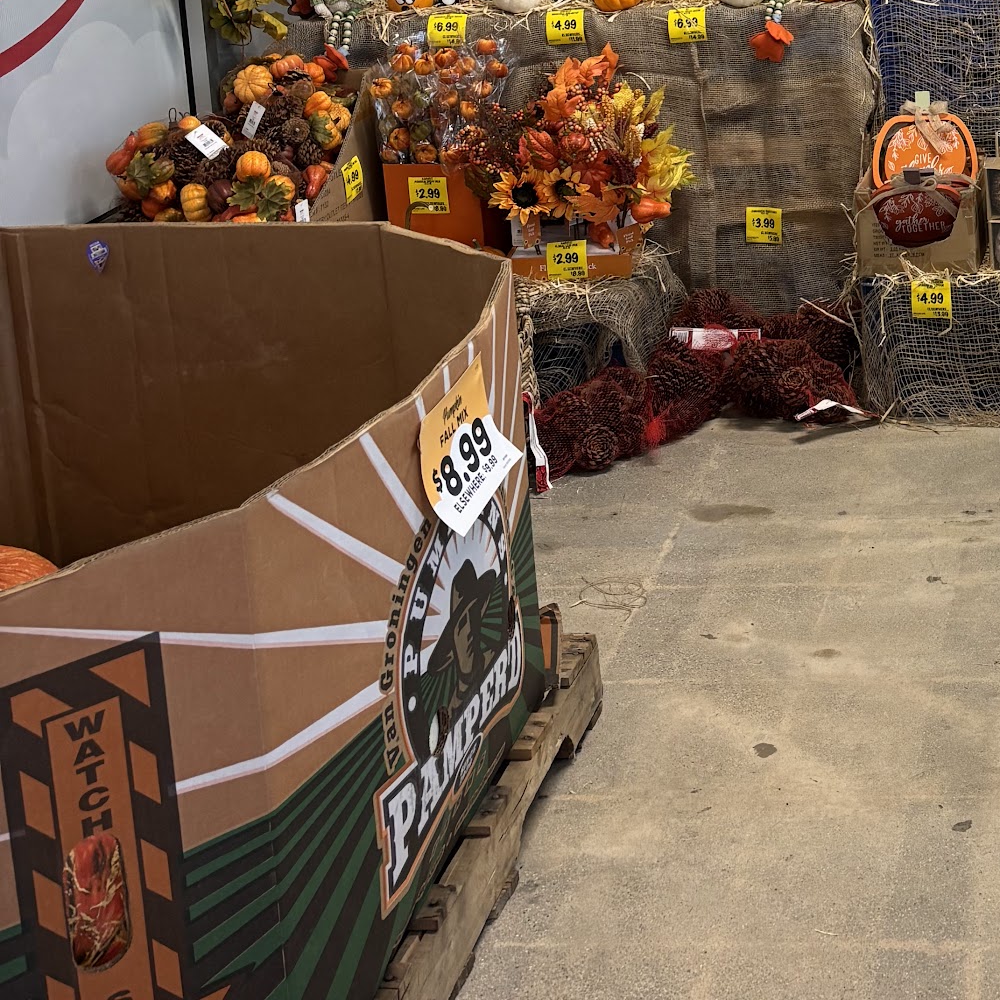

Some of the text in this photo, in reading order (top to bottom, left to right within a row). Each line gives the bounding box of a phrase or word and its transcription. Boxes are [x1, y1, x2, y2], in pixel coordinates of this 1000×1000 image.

[434, 21, 459, 32] $6.99
[551, 19, 577, 31] $4.99
[914, 152, 932, 165] GIVE
[415, 188, 440, 199] $2.99
[752, 217, 775, 229] $3.99
[901, 221, 946, 234] TOGETHER
[553, 252, 579, 265] $2.99
[916, 292, 944, 305] $4.99
[439, 405, 469, 449] FALL MIX
[432, 417, 492, 497] $8.99
[453, 454, 498, 514] ELSEWHERE: $9.99
[380, 519, 432, 772] Van Groningen
[63, 708, 113, 840] WATCH
